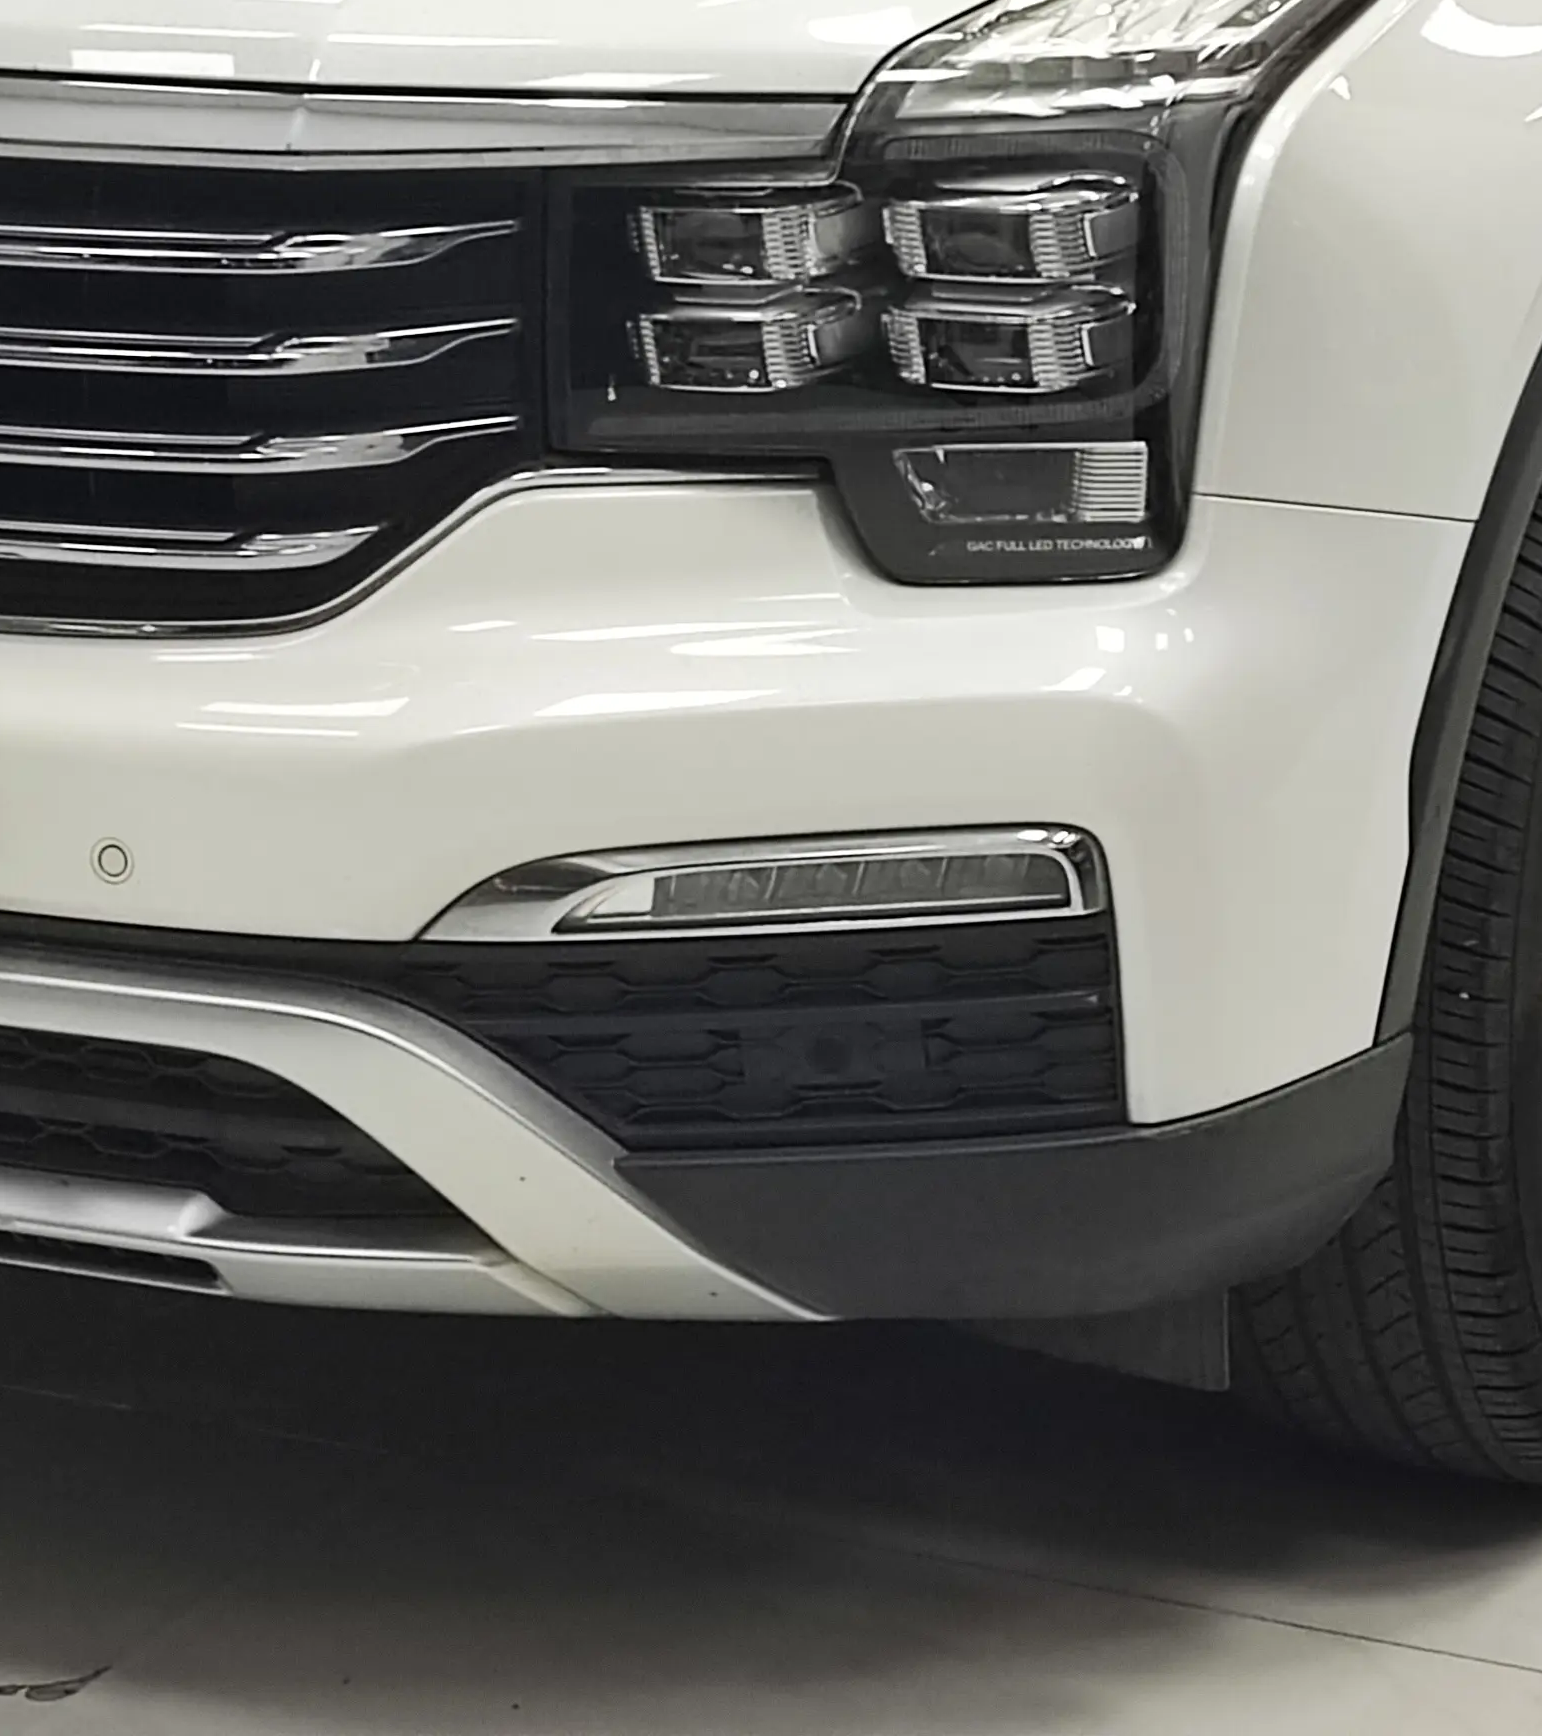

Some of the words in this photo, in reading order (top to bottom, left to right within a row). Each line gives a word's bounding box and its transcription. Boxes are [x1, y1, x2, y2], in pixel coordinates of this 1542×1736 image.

[966, 539, 994, 552] GAC
[996, 539, 1026, 551] FULL
[1028, 538, 1053, 551] LED
